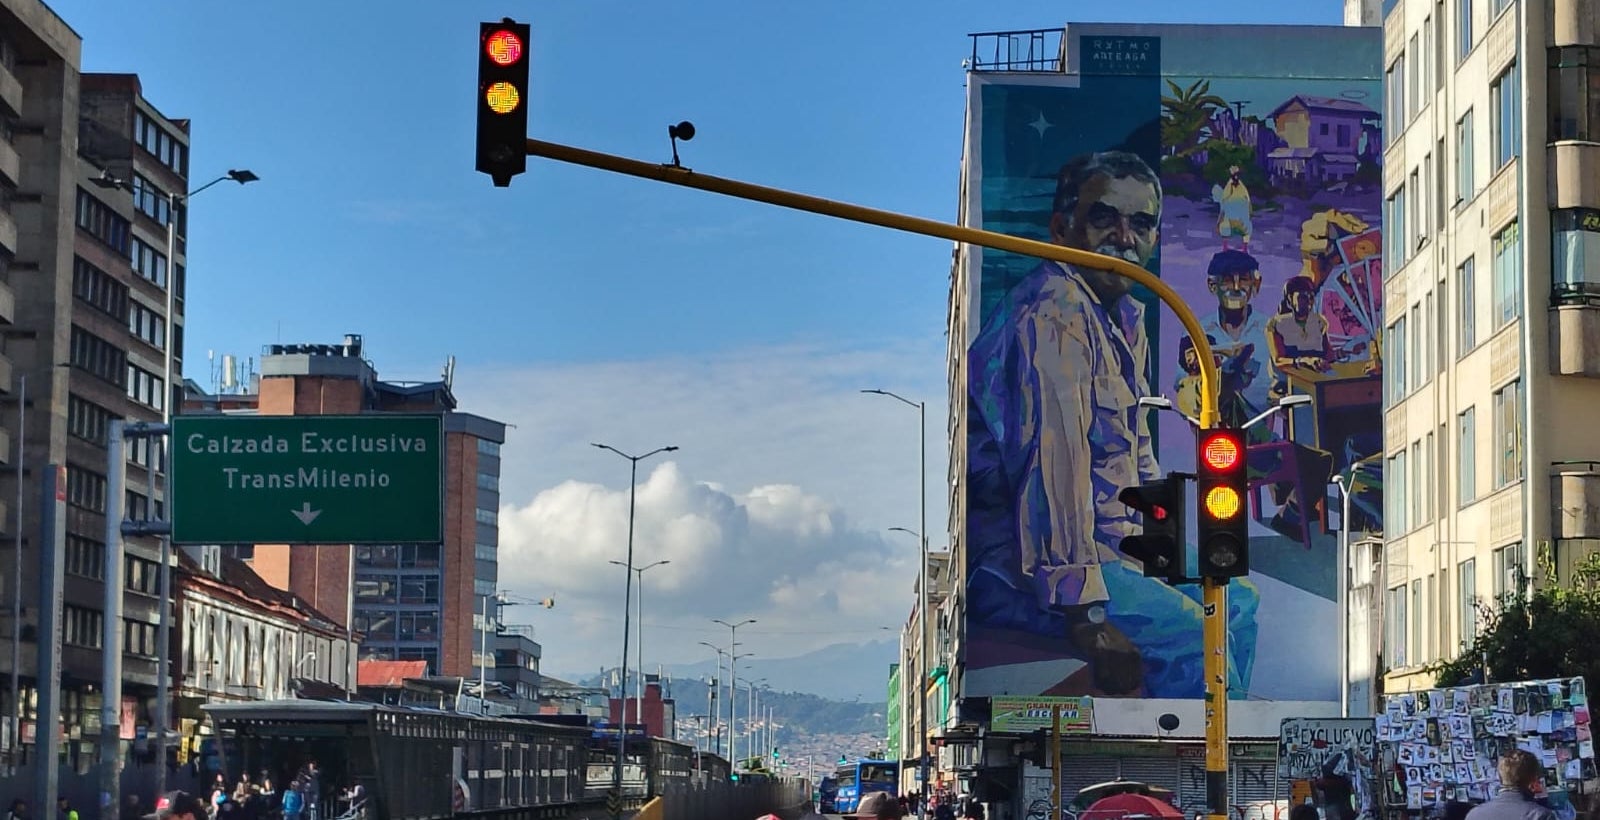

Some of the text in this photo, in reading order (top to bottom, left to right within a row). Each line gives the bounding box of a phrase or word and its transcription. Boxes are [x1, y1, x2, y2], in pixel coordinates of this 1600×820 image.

[187, 432, 427, 453] Calzada Exclusiva
[223, 467, 391, 489] TransMilenio
